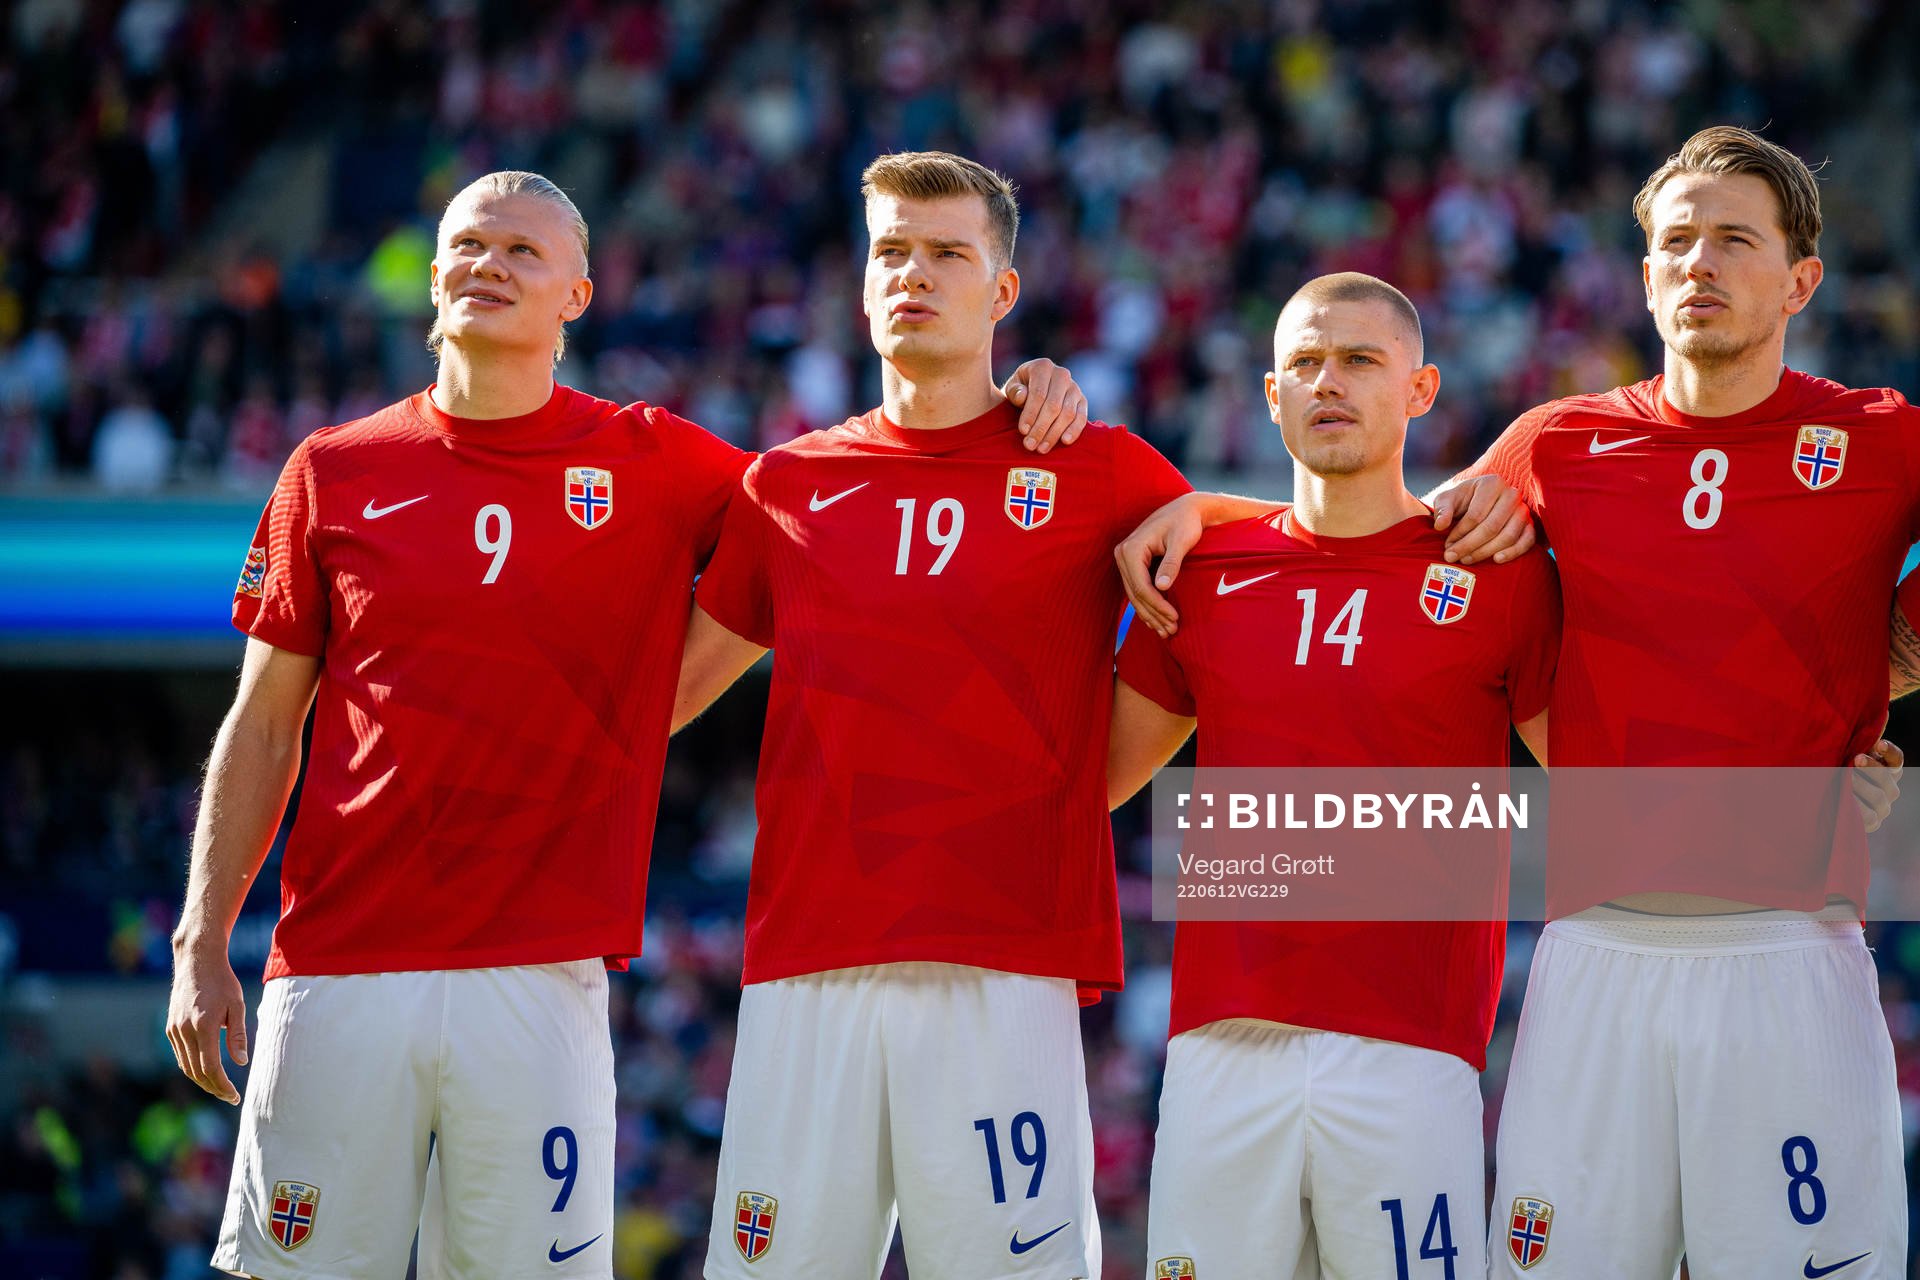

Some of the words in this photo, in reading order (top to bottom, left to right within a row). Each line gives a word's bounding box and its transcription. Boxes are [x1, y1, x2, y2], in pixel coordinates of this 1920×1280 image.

[1683, 448, 1729, 530] 8
[474, 503, 512, 585] 9
[895, 498, 964, 576] 19
[1294, 588, 1368, 666] 14
[541, 1126, 579, 1213] 9
[974, 1111, 1047, 1205] 19
[1782, 1135, 1827, 1226] 8
[1380, 1192, 1459, 1280] 14
